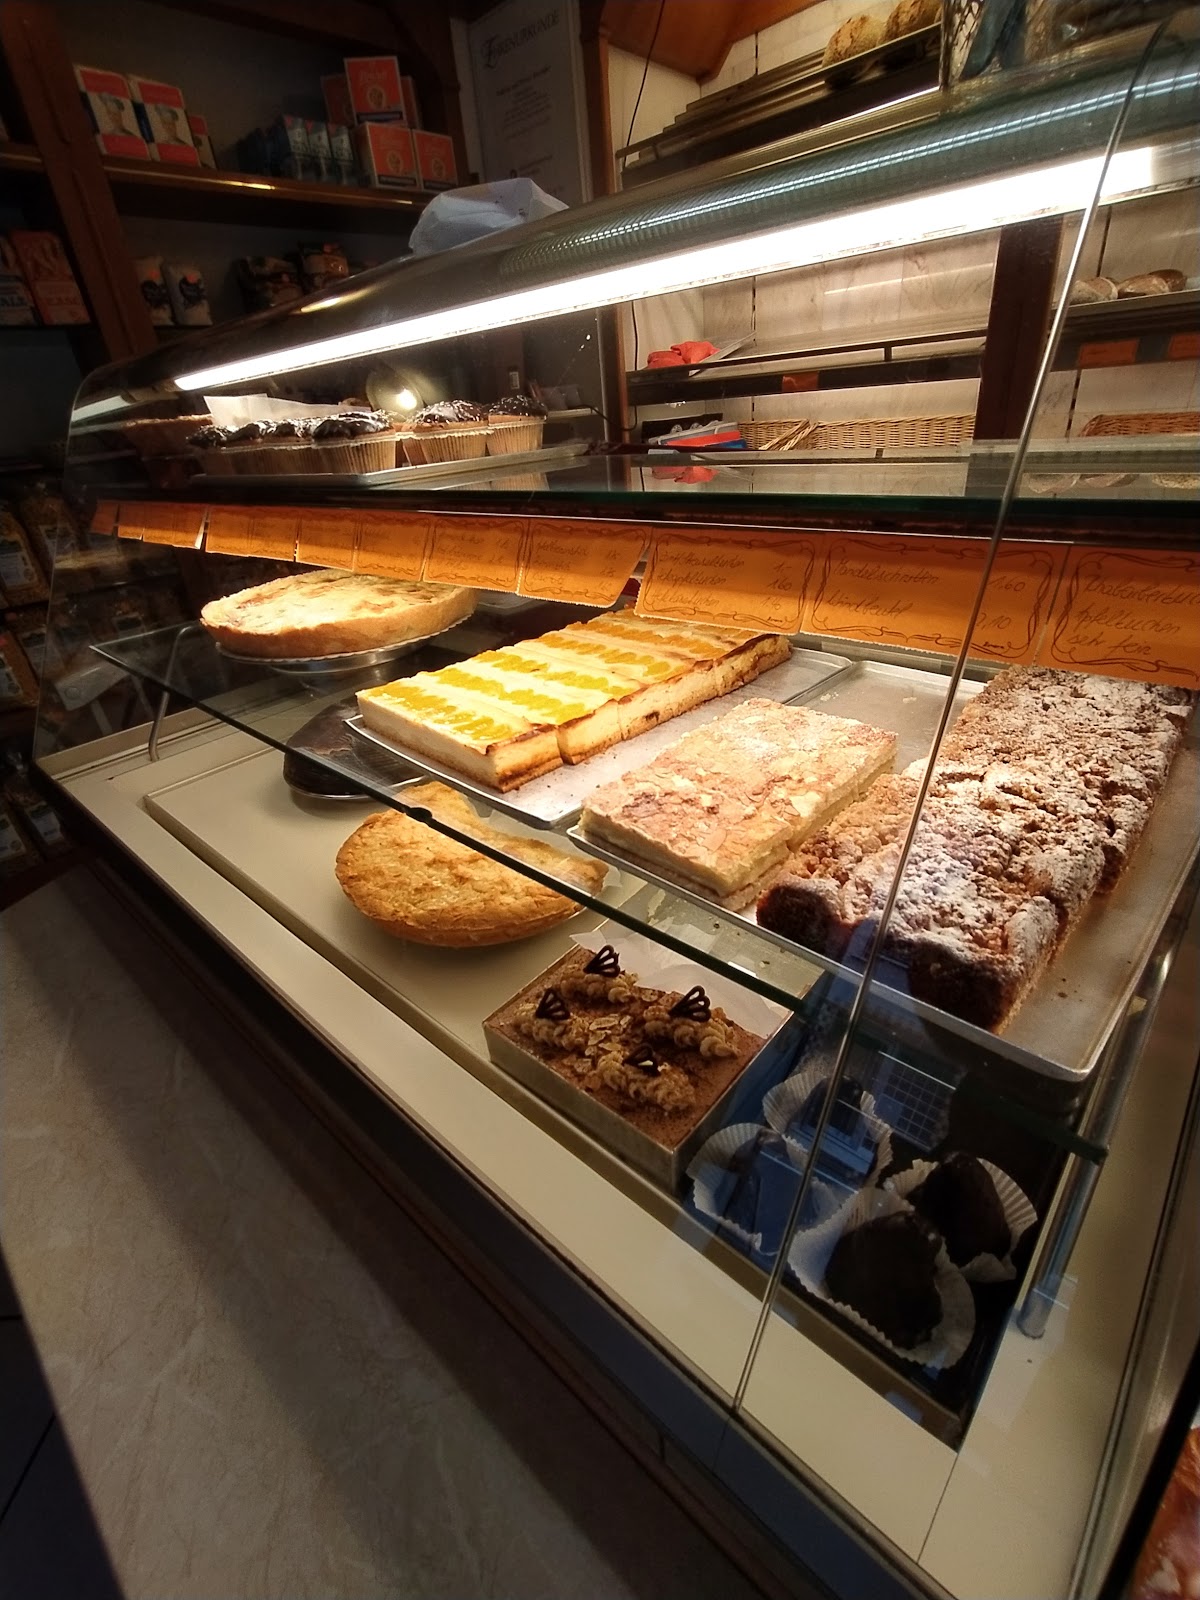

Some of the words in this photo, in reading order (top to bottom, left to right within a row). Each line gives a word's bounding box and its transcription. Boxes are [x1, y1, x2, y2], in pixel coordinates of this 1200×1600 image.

[827, 589, 914, 619] Windbeutel
[1073, 602, 1180, 632] Apfelkuchen
[1104, 634, 1152, 659] fein
